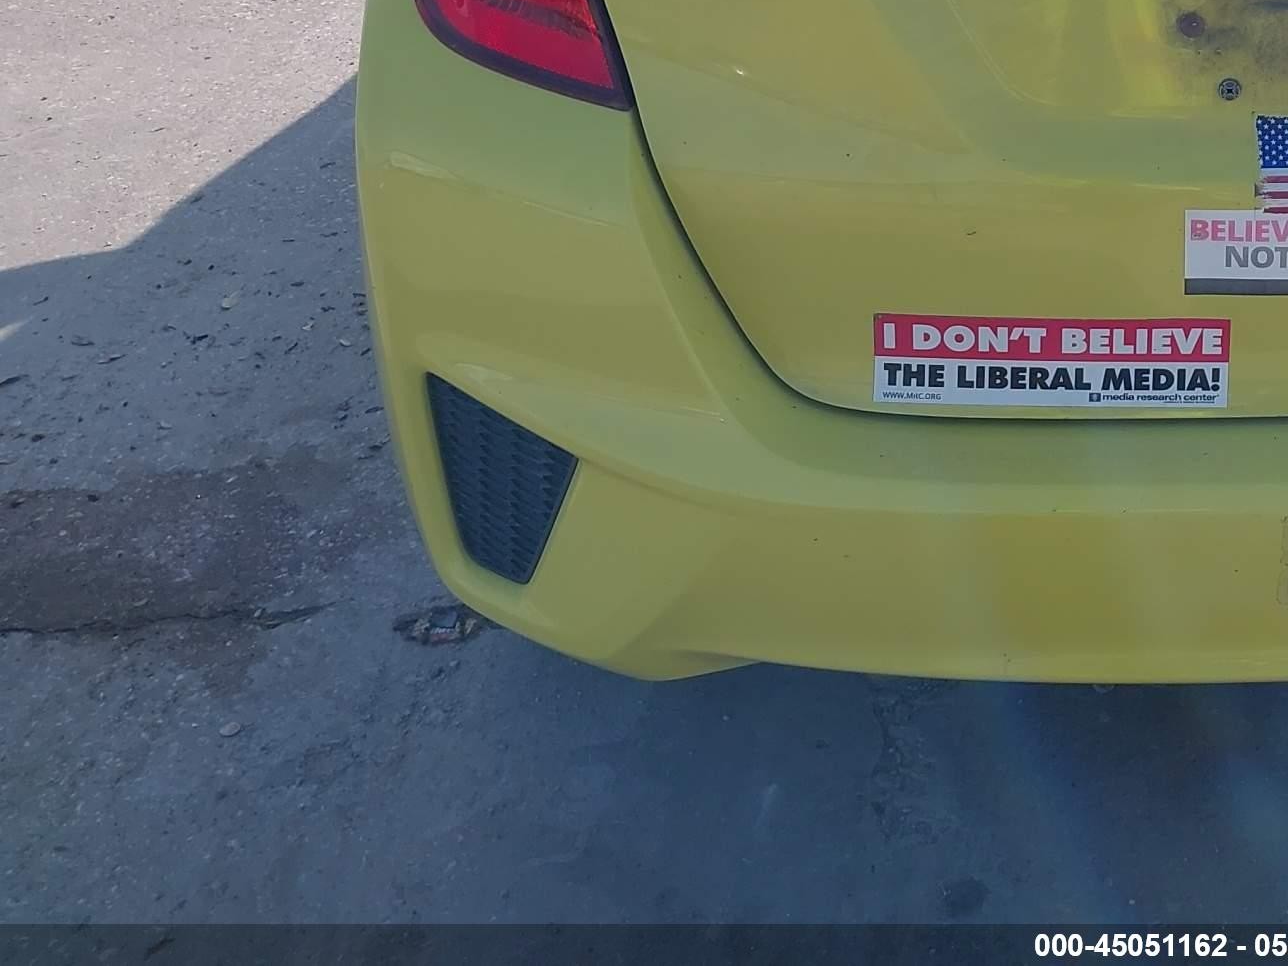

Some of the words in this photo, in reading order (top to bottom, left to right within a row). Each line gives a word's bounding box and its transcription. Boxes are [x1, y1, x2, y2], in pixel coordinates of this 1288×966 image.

[883, 322, 896, 349] I
[912, 324, 1047, 354] DON'T
[1061, 327, 1223, 355] BELIEVE
[883, 362, 945, 388] THE
[957, 364, 1092, 391] LIBERAL
[1100, 366, 1221, 392] MEDIA!
[1102, 392, 1134, 401] media
[1136, 393, 1181, 401] research
[1183, 393, 1217, 401] center
